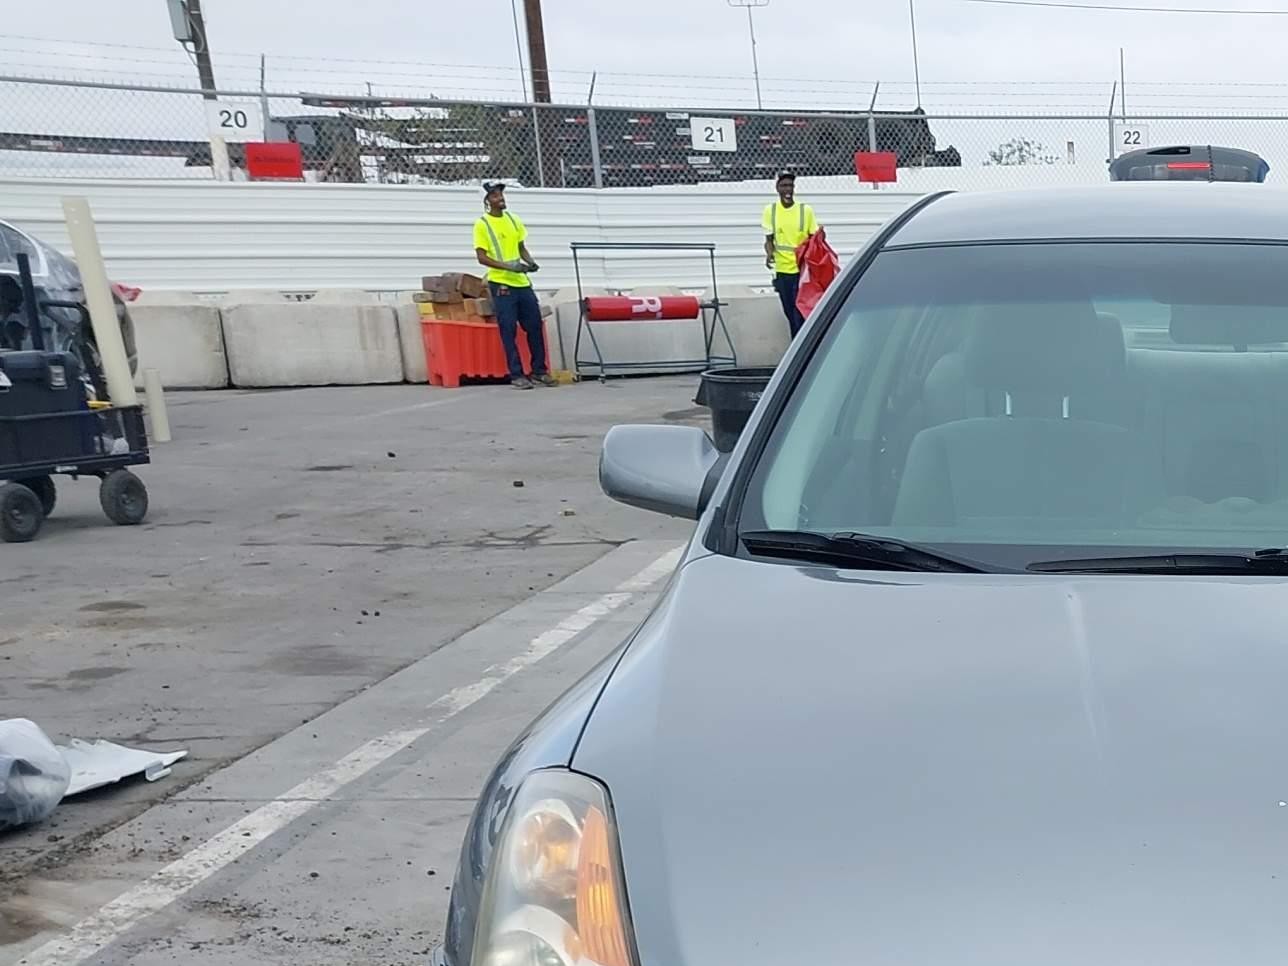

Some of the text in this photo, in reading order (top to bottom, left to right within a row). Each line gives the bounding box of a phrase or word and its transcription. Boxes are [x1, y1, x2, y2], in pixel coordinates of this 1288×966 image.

[219, 109, 248, 129] 20
[703, 126, 725, 143] 21
[1123, 130, 1142, 145] 22
